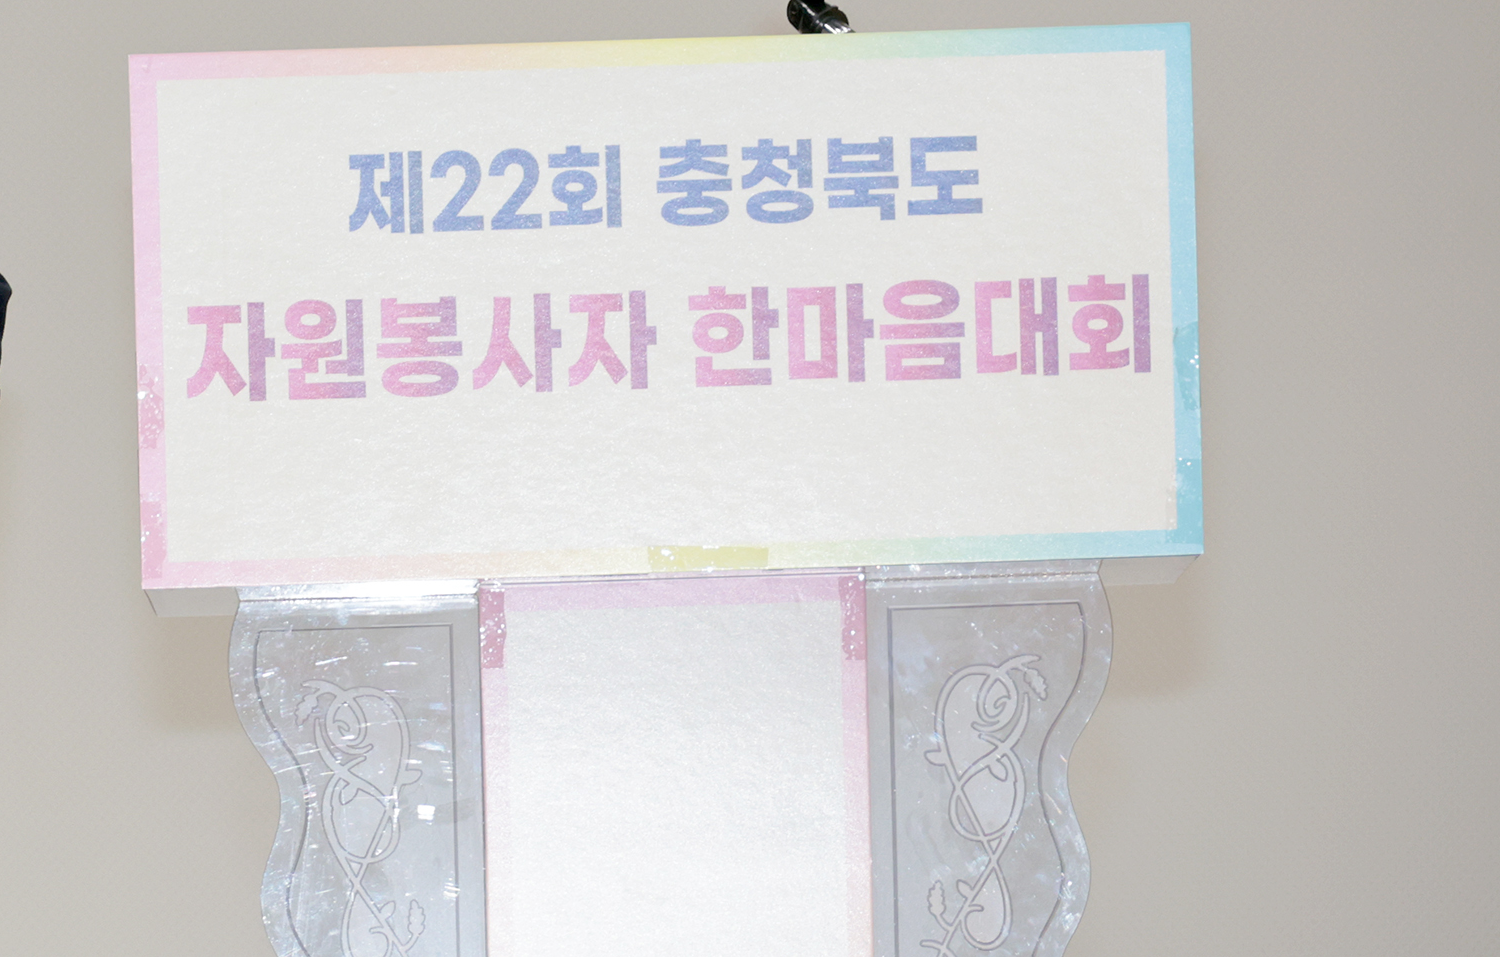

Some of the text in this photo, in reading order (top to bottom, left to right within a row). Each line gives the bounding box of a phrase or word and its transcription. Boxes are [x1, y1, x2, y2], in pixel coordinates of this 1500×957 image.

[348, 135, 983, 234] 제22회 충청북도
[186, 274, 1152, 401] 자원봉사자 한마음대회
